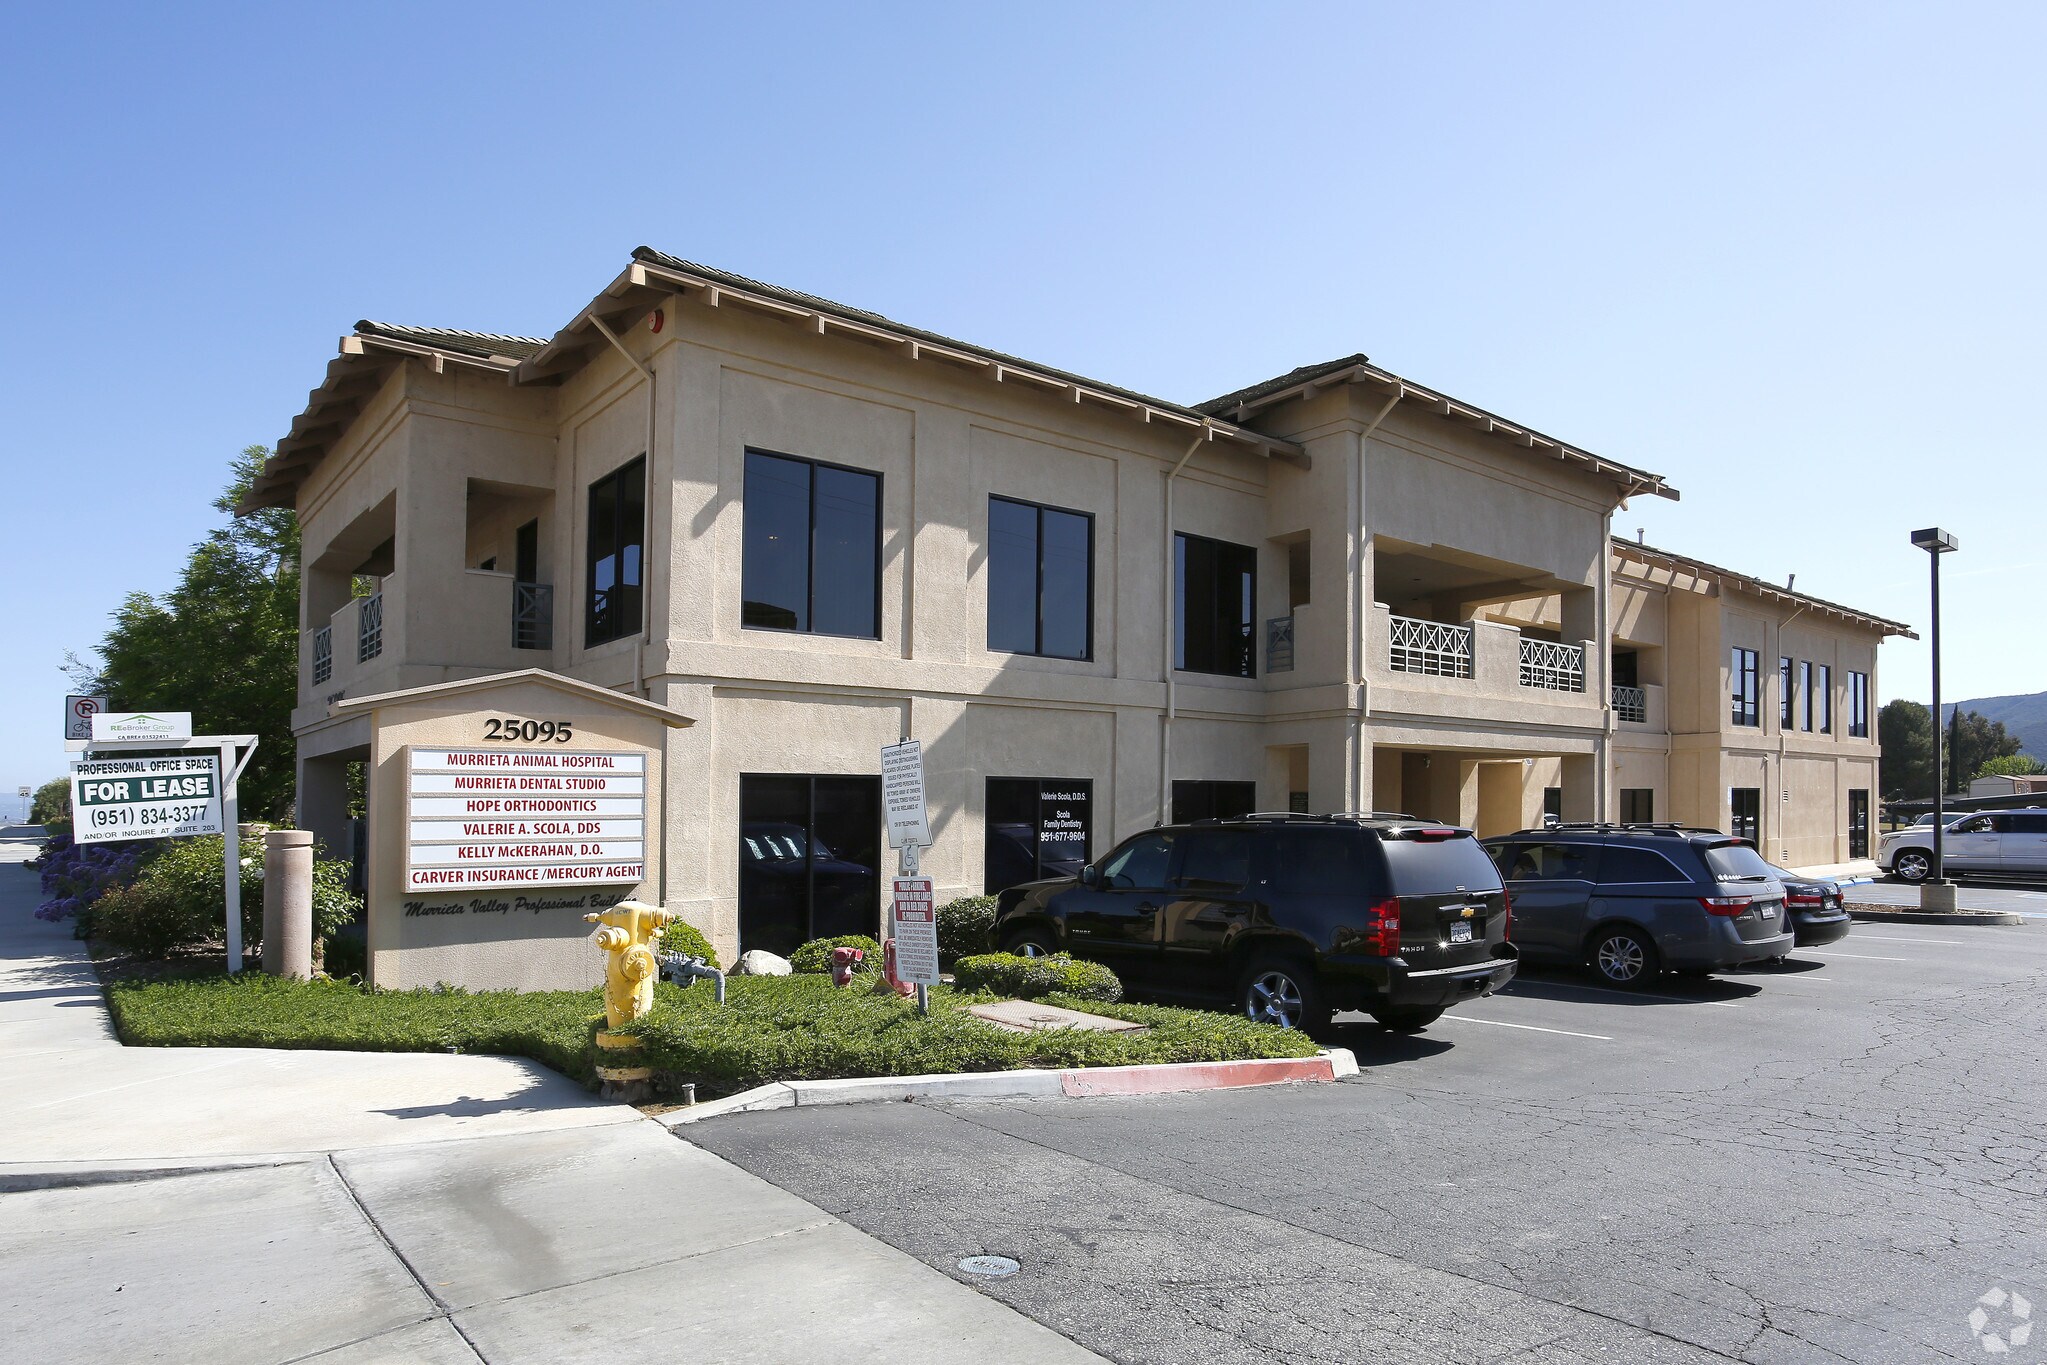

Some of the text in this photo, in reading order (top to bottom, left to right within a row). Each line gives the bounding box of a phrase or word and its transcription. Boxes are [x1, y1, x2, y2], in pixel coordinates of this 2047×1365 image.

[484, 719, 572, 742] 25095
[77, 758, 213, 775] PROFESSIONAL OFFICE SPACE
[447, 754, 614, 768] MURRIETA ANIMAL HOSPITAL
[84, 778, 209, 802] FOR LEASE
[454, 777, 606, 790] MURRIETA DENTAL STUDIO
[466, 800, 596, 812] HOPE ORTHODONTICS
[92, 805, 207, 828] (951) 834-3377
[464, 822, 600, 836] VALERIE A. SCOLA, DDS
[1044, 820, 1082, 830] Family Dentistry
[84, 831, 117, 840] AND/OR
[122, 828, 156, 837] INQUIRE
[174, 825, 198, 833] SUITE
[1040, 832, 1085, 842] 951-677-9604
[458, 844, 603, 858] KELLY McKERAHAN, D.O.
[412, 865, 642, 884] CARVER INSURANCE /MERCURY AGENT
[404, 902, 465, 917] Murrieta
[470, 899, 510, 915] Valley
[514, 896, 585, 914] Professional
